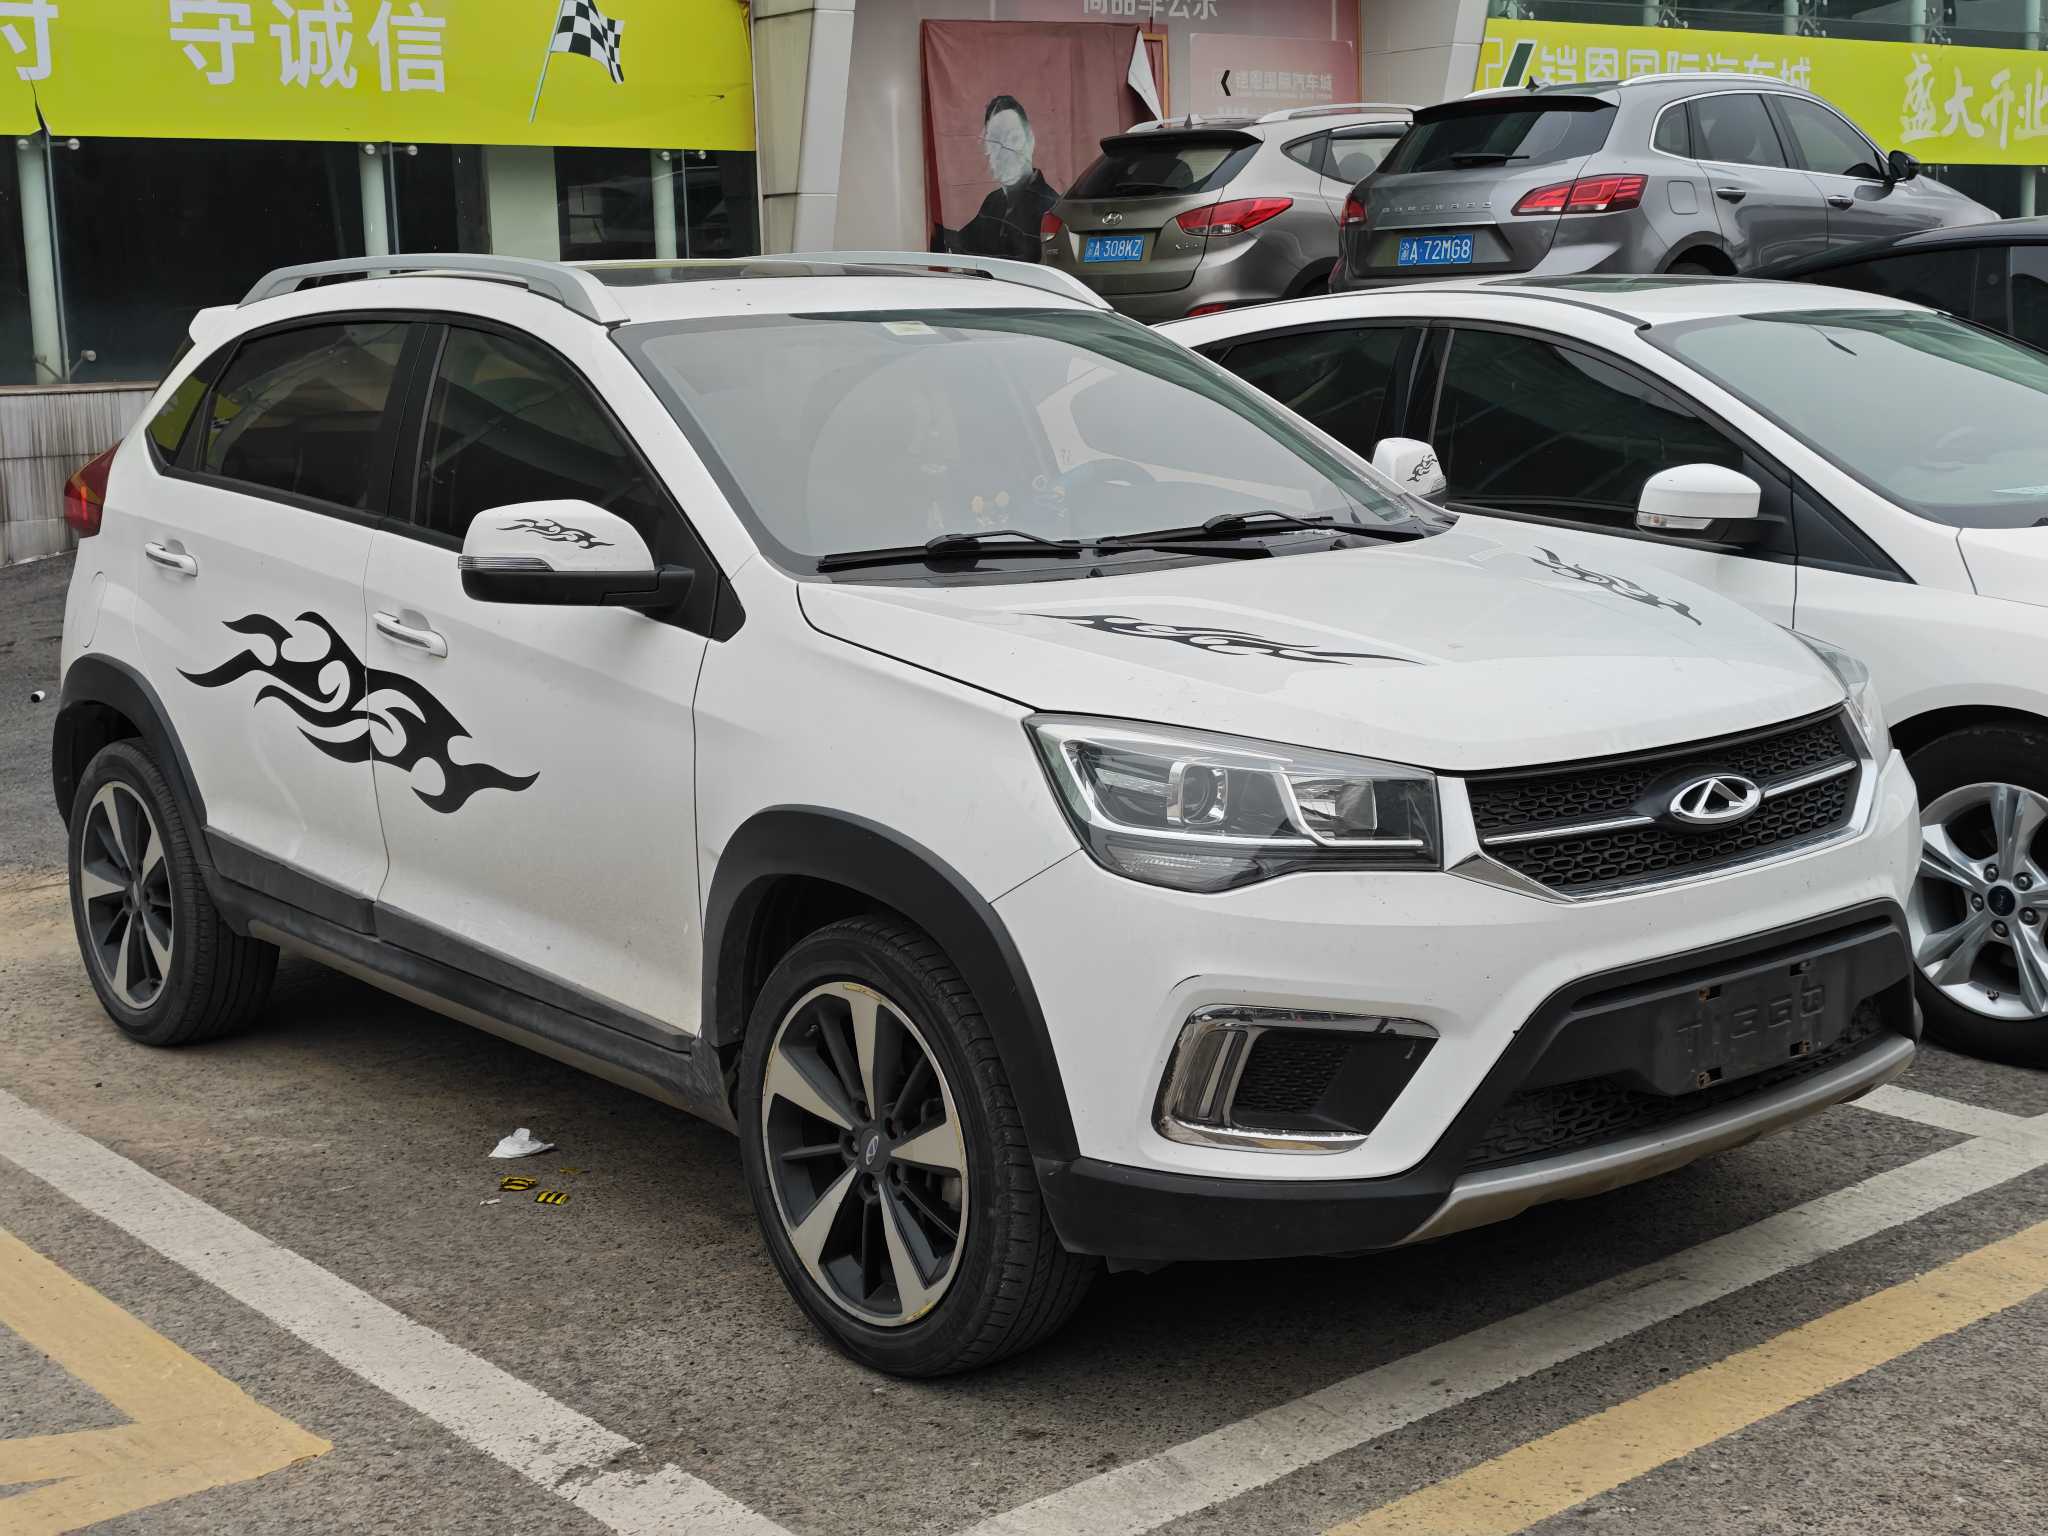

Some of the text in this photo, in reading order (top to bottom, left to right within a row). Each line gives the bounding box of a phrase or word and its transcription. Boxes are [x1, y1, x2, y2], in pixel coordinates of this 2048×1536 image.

[169, 0, 447, 92] 守诚信
[1900, 52, 2048, 150] 盛大开业
